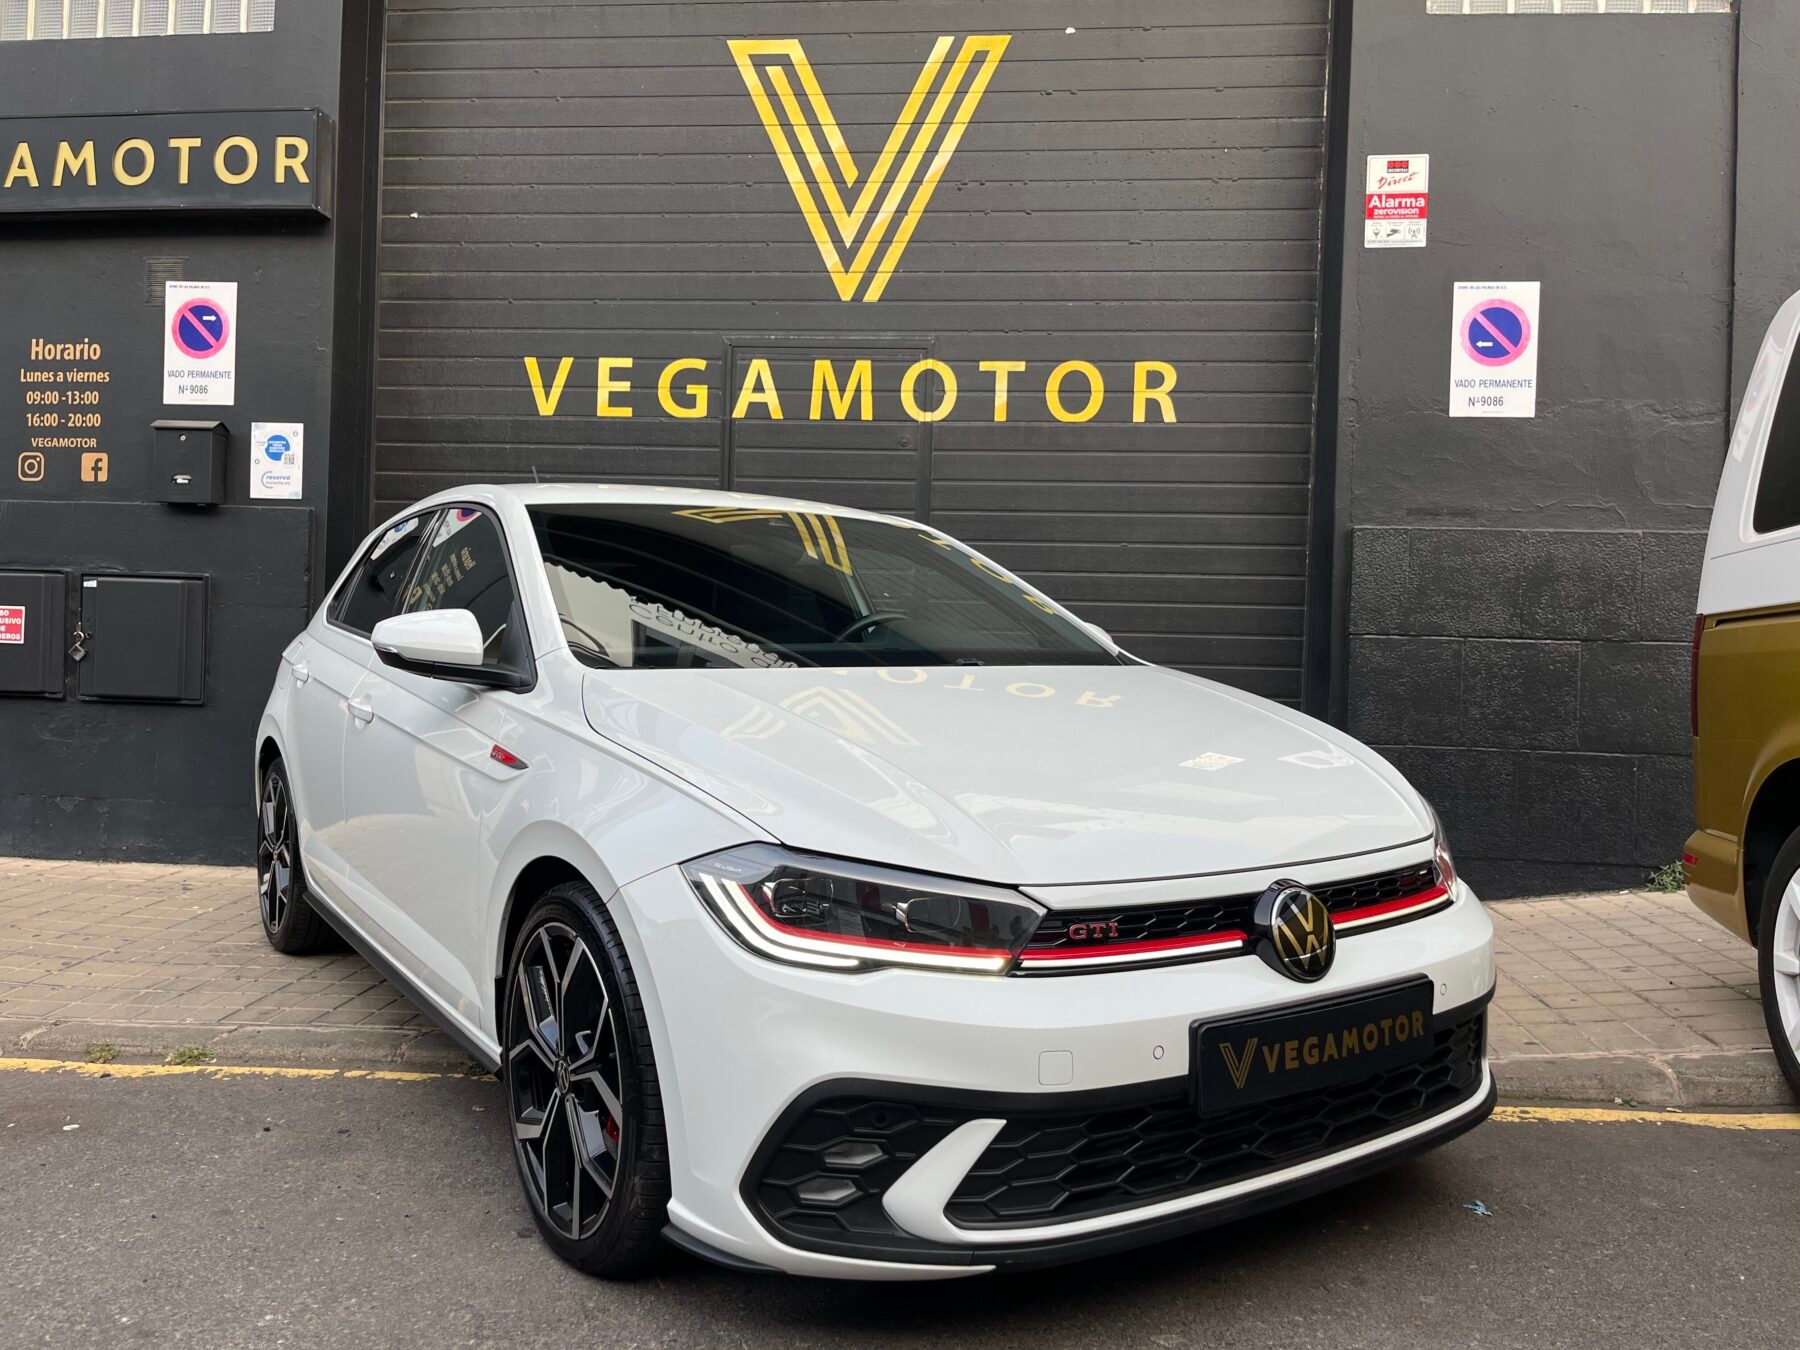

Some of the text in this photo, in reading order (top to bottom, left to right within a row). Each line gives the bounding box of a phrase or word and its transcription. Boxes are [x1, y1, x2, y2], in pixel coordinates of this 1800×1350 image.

[3, 135, 310, 187] AMOTOR
[1368, 194, 1425, 208] Alarma
[30, 338, 101, 361] Horario
[20, 368, 110, 382] Lunes a viernes
[167, 369, 232, 379] VADO PERMANENTE
[523, 356, 1179, 424] VEGAMOTOR
[1454, 379, 1533, 388] VADO PERMANENTE
[26, 391, 59, 405] 09:00
[26, 413, 58, 427] 16:00
[67, 413, 101, 427] 20:00
[31, 437, 97, 448] VEGAMOTOR
[1068, 921, 1119, 941] GTI
[1262, 1010, 1425, 1073] VEGAMOTOR
